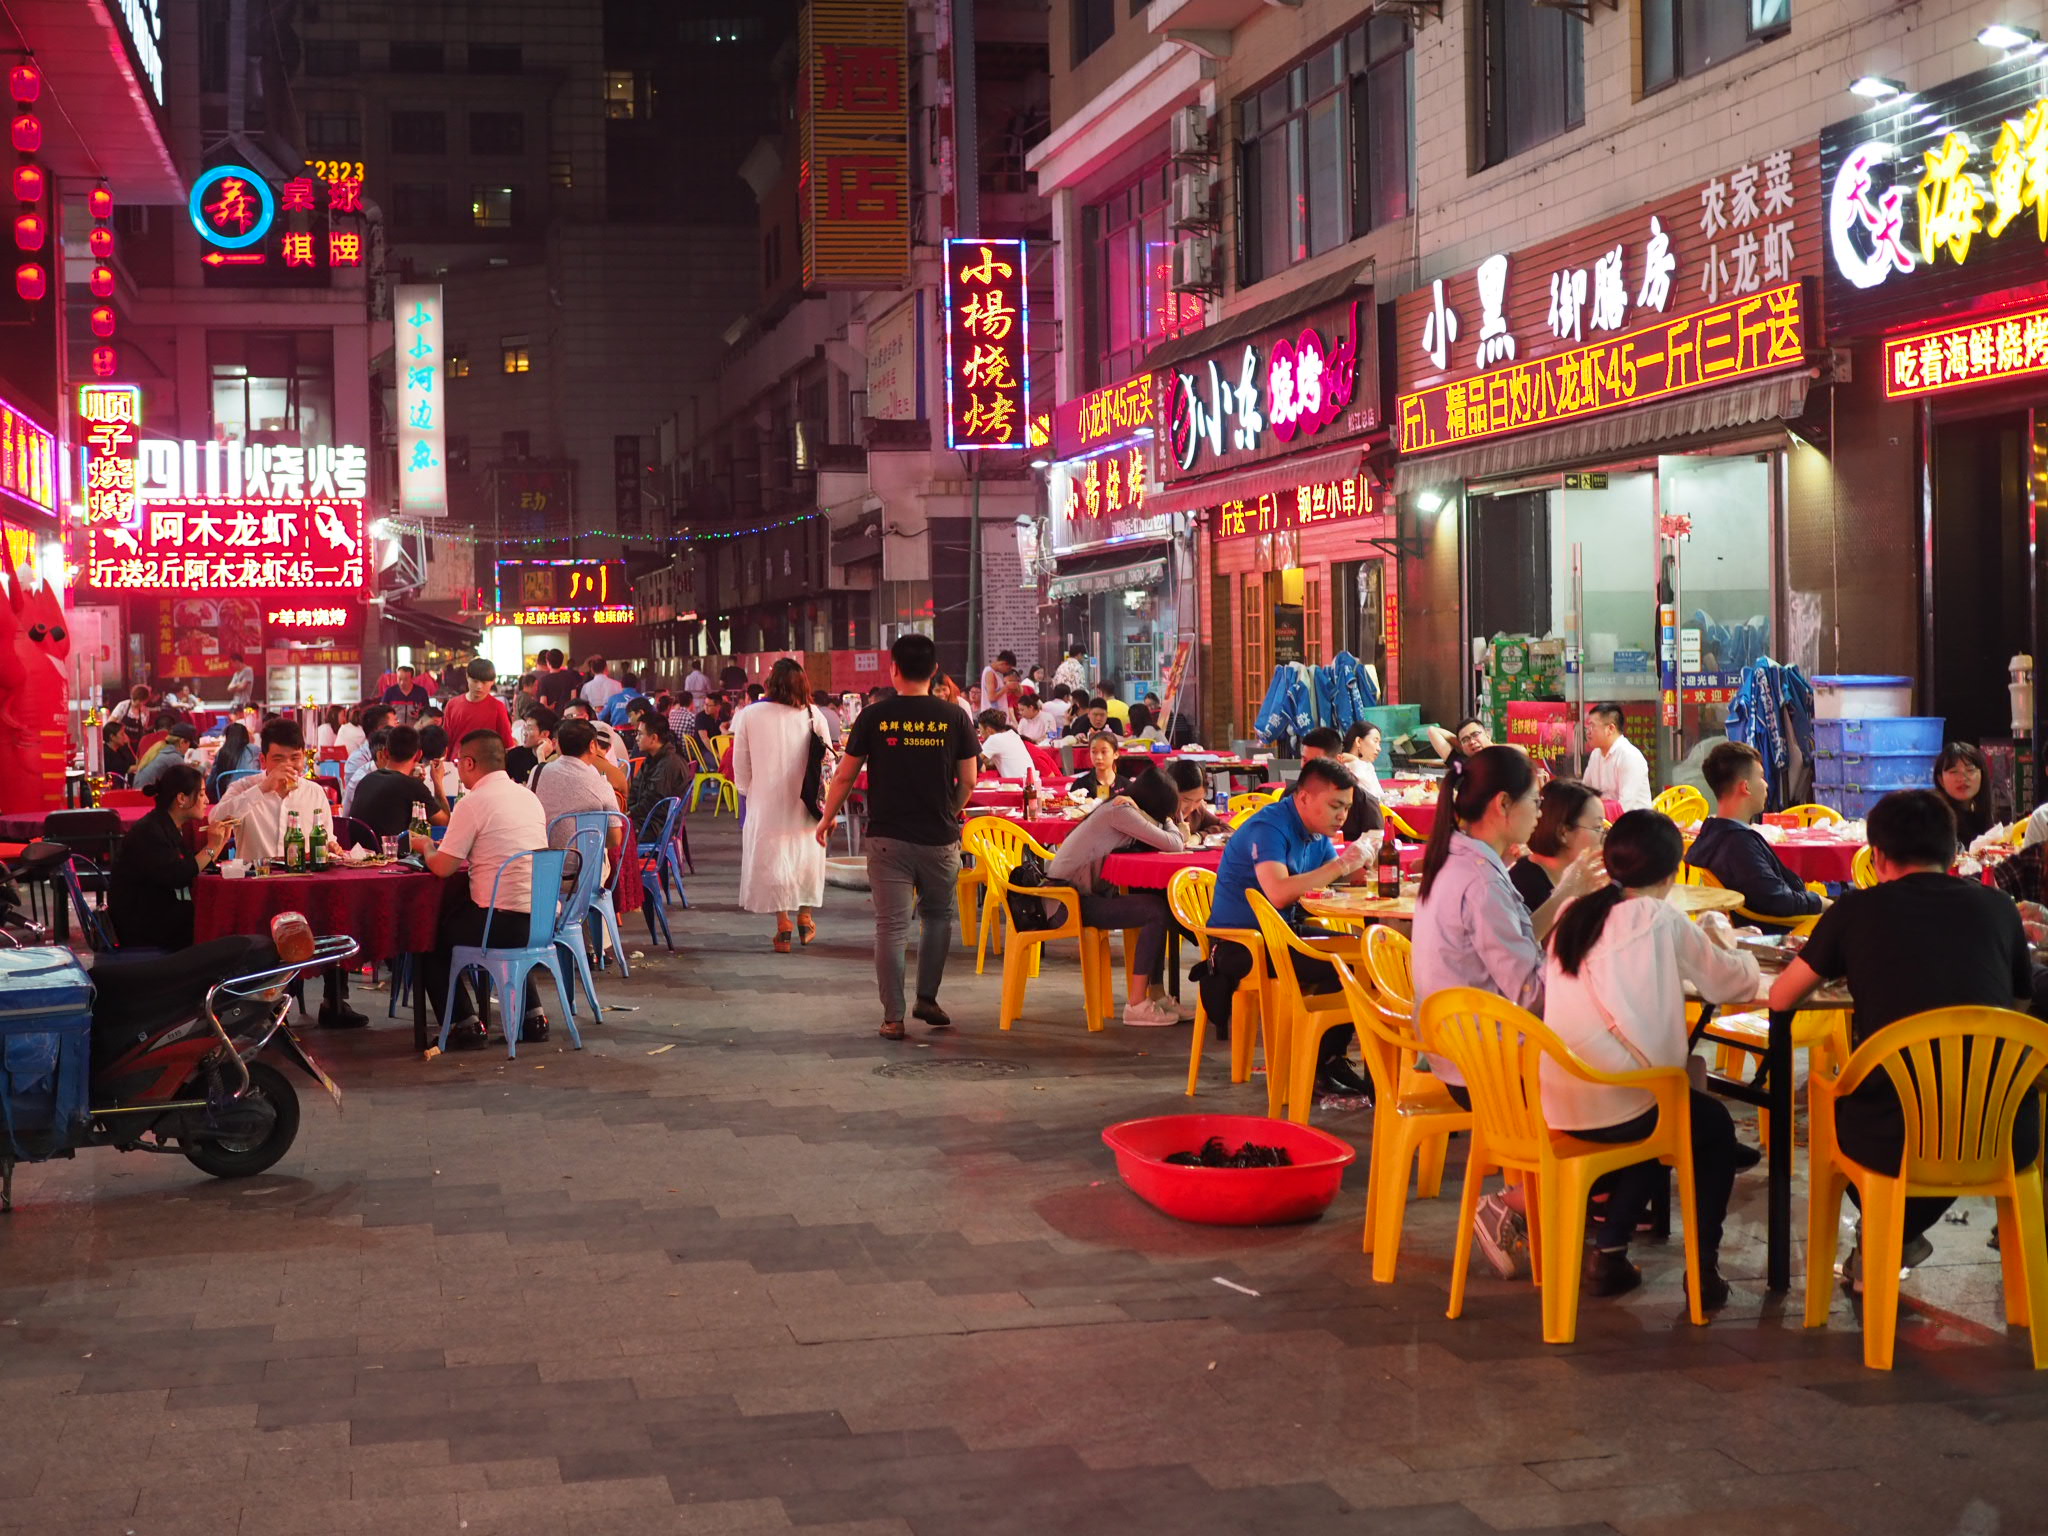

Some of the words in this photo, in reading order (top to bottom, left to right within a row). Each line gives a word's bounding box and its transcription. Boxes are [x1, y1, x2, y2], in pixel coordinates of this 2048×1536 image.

[305, 160, 365, 182] 2323
[1700, 150, 1796, 241] 农家菜
[282, 231, 363, 268] 棋牌
[1700, 219, 1796, 304] 小龙虾
[1422, 253, 1516, 370] 小黑
[1548, 215, 1676, 342] 御膳房
[1269, 343, 1324, 424] 烧烤
[1894, 313, 2048, 388] 吃着海鲜烧烤
[1079, 373, 1154, 443] 小龙虾45元买
[87, 391, 135, 523] 顺子烧烤
[138, 439, 367, 499] 四川烧烤
[150, 510, 298, 548] 阿木龙虾
